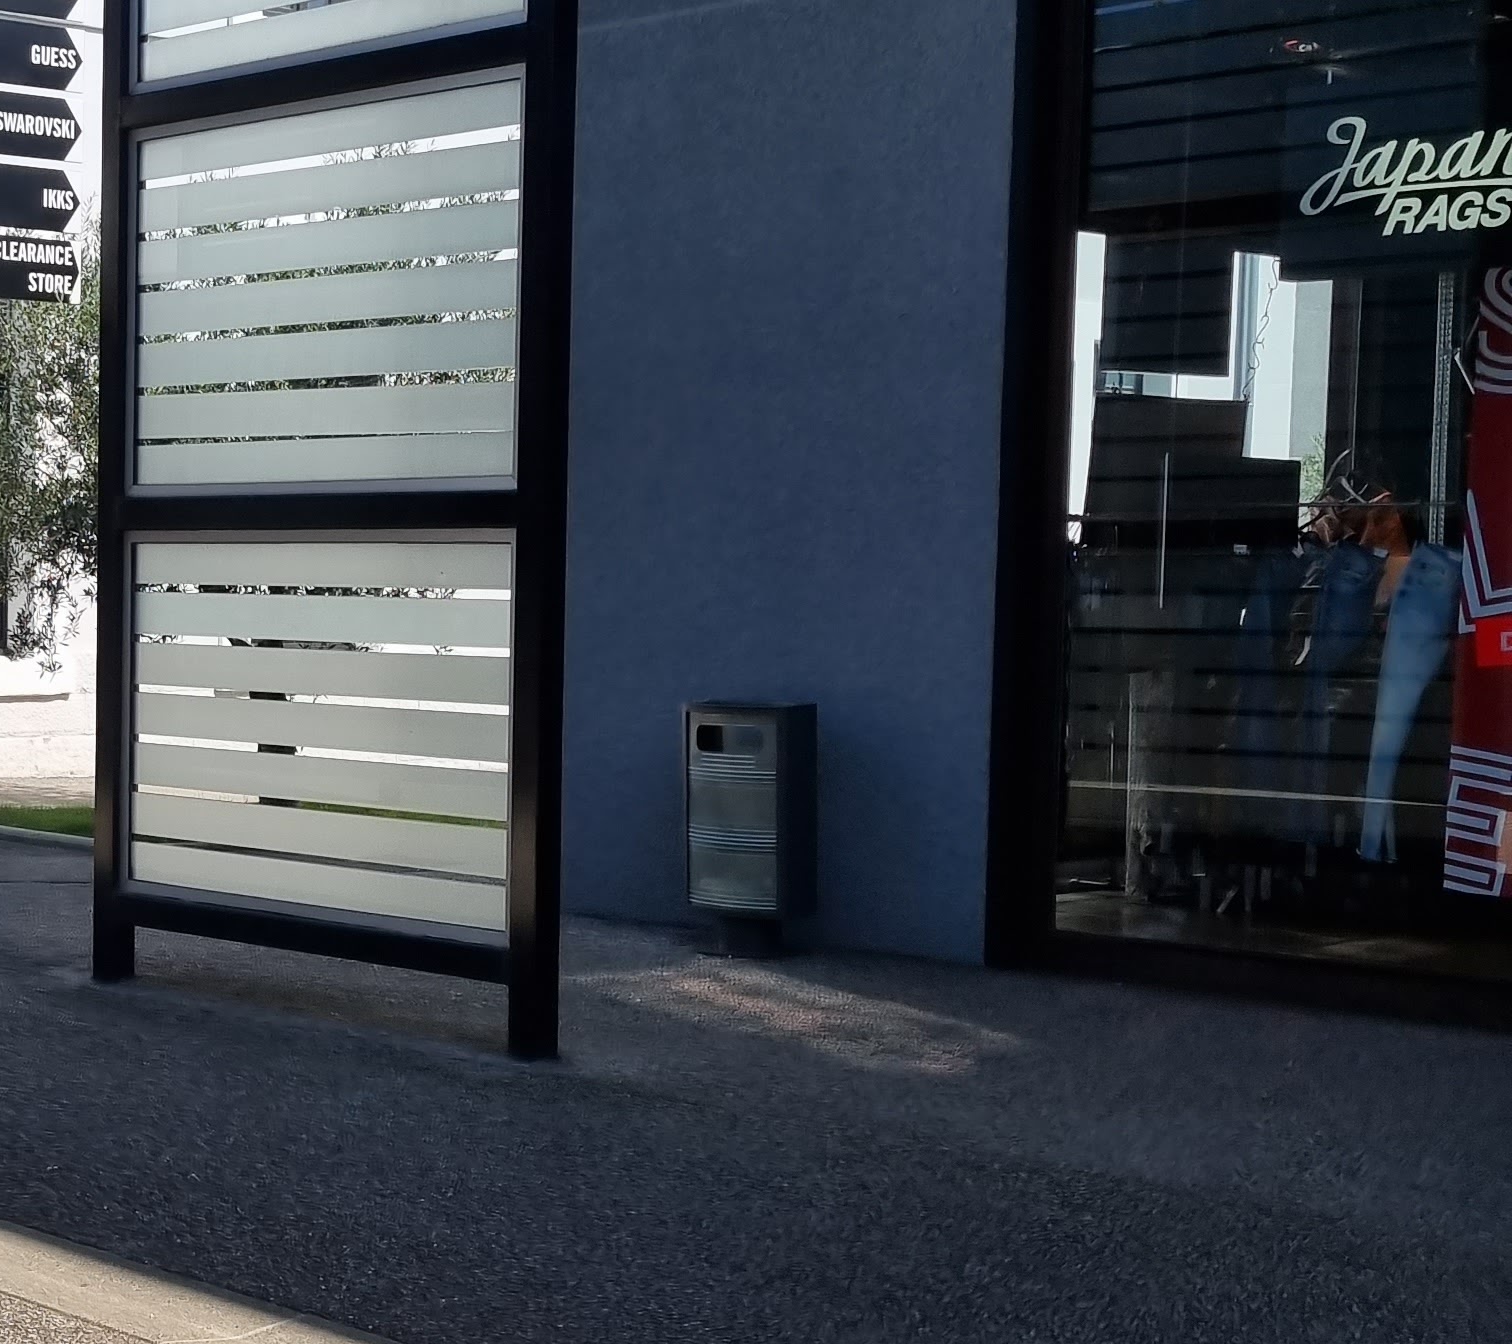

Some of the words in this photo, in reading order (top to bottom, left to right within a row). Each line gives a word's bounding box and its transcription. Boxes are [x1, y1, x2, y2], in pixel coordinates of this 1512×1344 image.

[31, 44, 77, 69] GUESS
[43, 188, 74, 210] IKKS
[1382, 188, 1512, 236] RAGS
[28, 272, 73, 295] STORE
